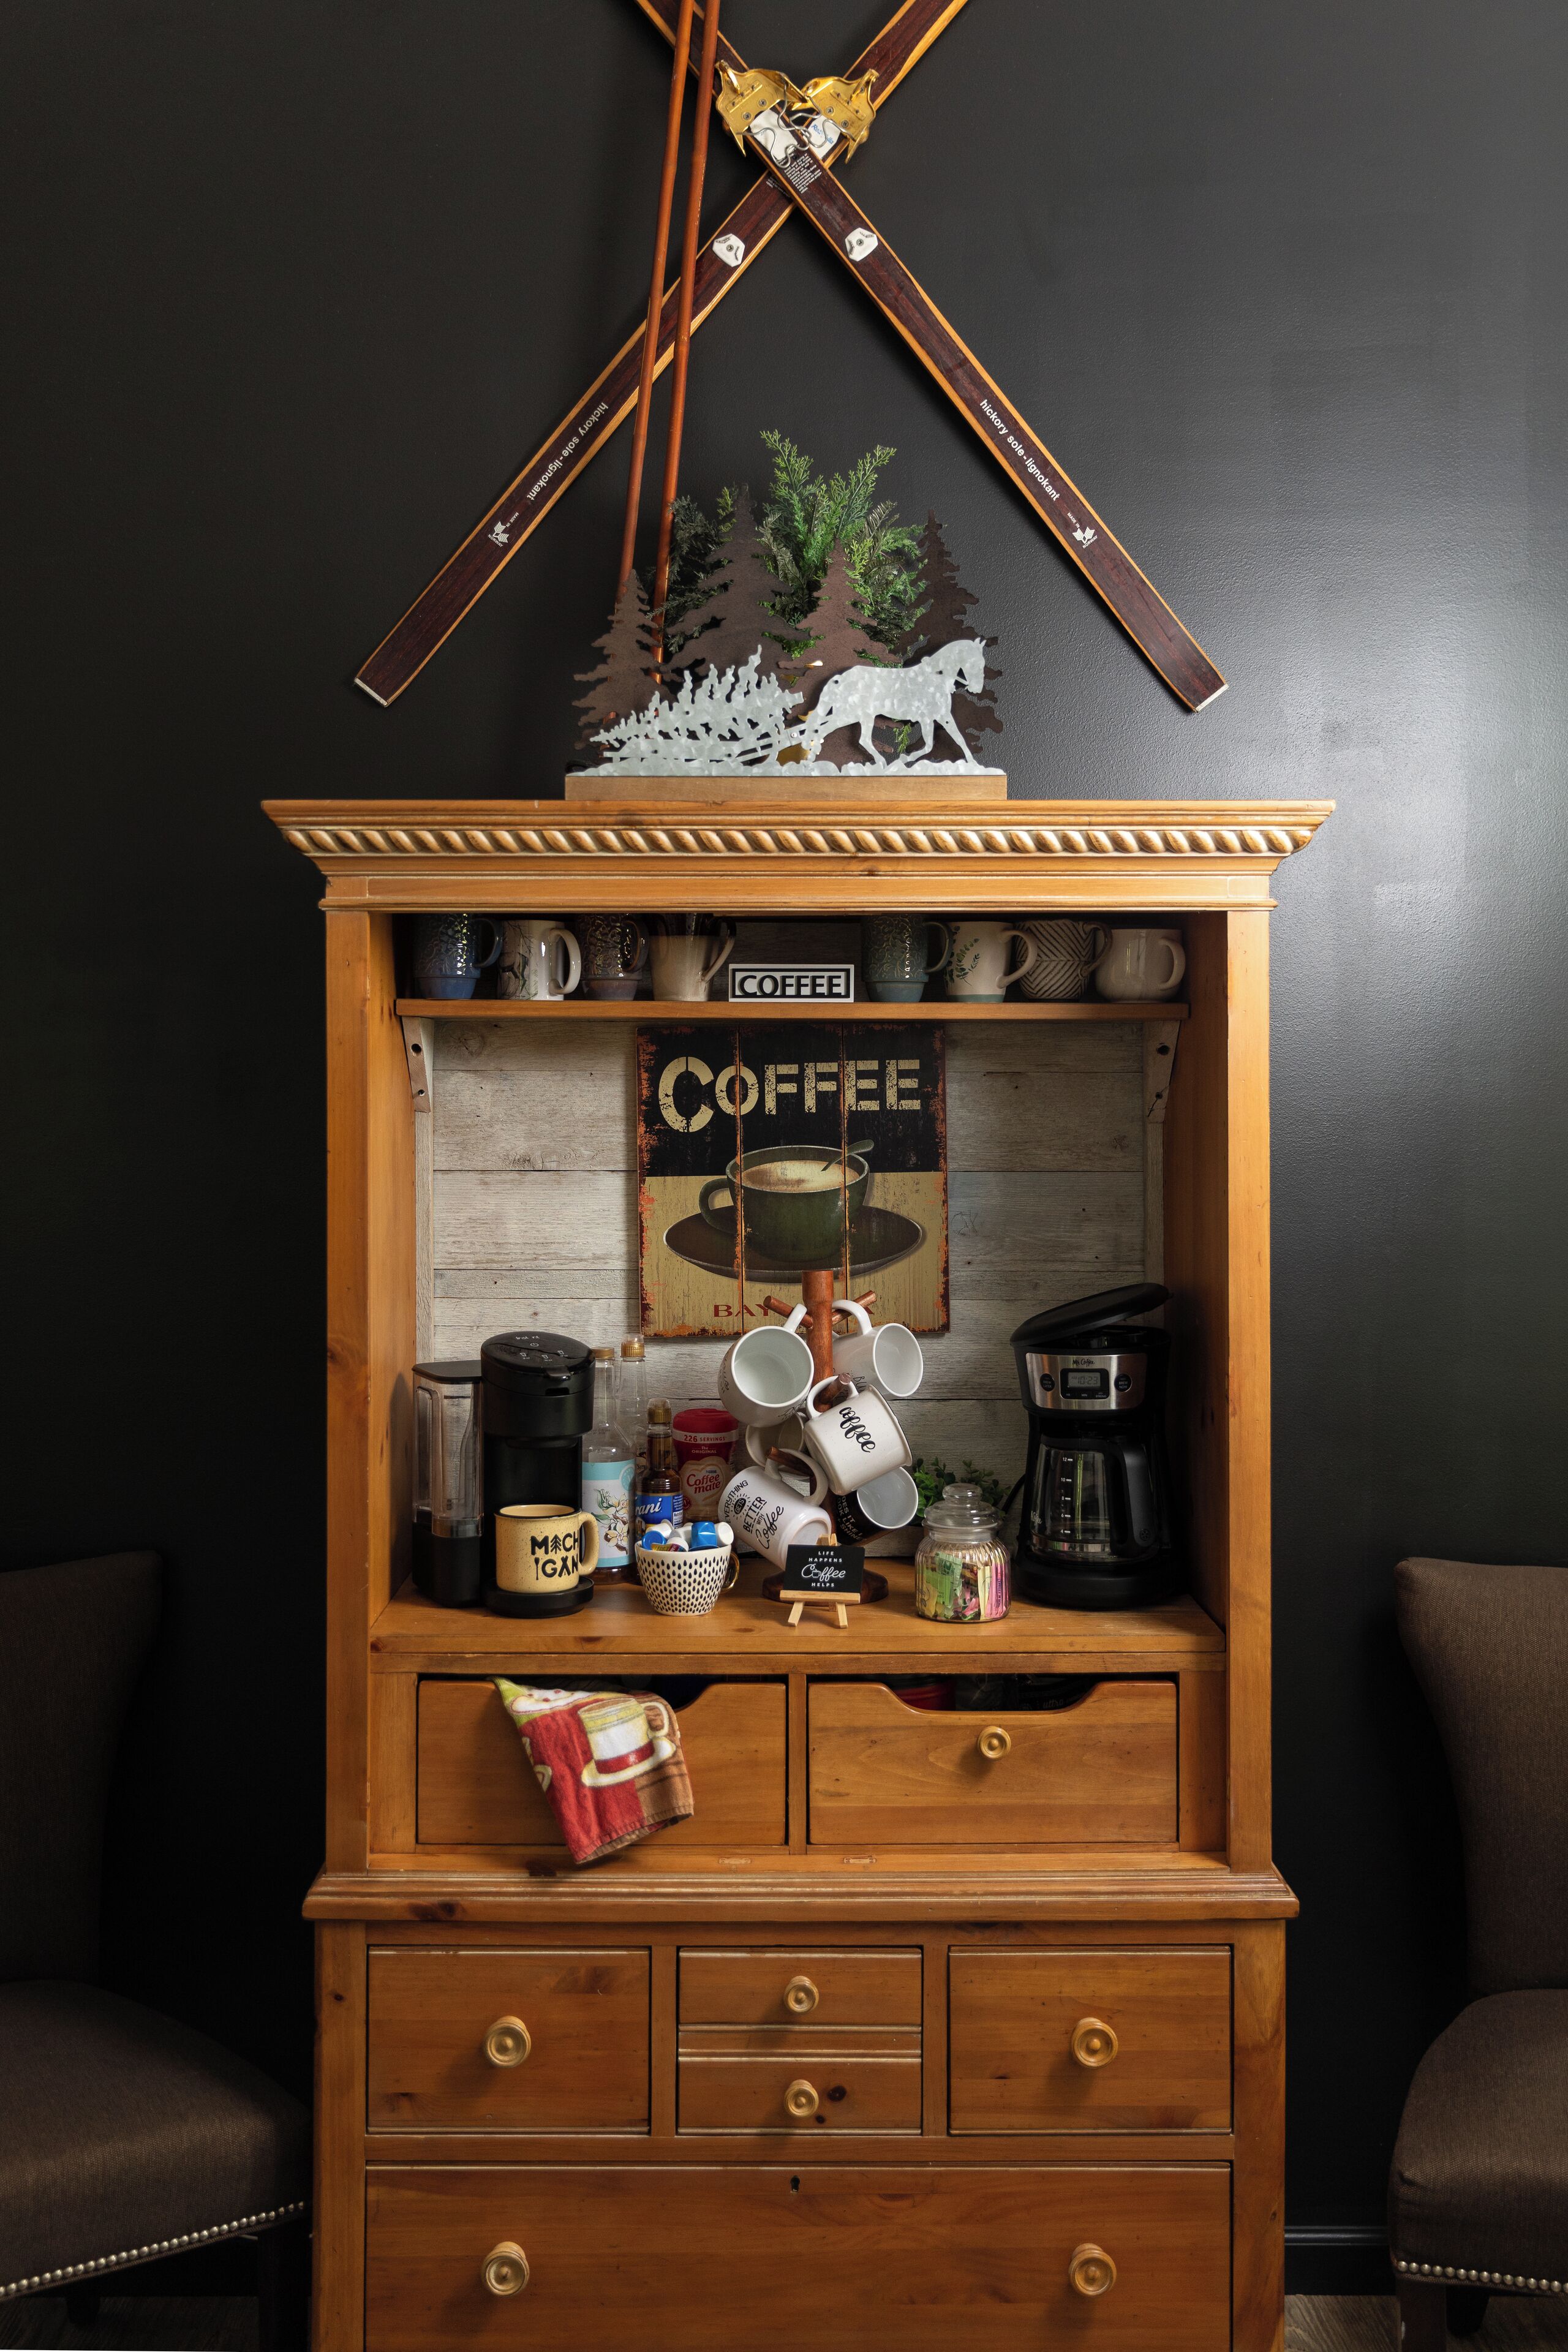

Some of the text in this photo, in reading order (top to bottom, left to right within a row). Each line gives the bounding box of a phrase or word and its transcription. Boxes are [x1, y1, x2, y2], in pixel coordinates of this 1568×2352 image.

[578, 402, 609, 436] hickory
[980, 399, 1008, 435] hickory
[510, 512, 519, 523] MADE
[1067, 512, 1077, 524] MADE
[488, 534, 503, 548] NORWAY
[1082, 535, 1098, 548] NORWAY
[739, 974, 842, 997] COFFEE
[658, 1057, 921, 1133] COFFEE
[1080, 1358, 1095, 1367] Coffee
[839, 1407, 876, 1453] coffee
[687, 1474, 720, 1487] Coffee
[694, 1482, 720, 1494] mate
[724, 1480, 748, 1523] EVERYTHING
[735, 1498, 745, 1513] GETS
[743, 1496, 766, 1532] BETTER
[756, 1513, 765, 1525] WITH
[756, 1506, 784, 1549] Coffee
[801, 1563, 846, 1581] Coffee
